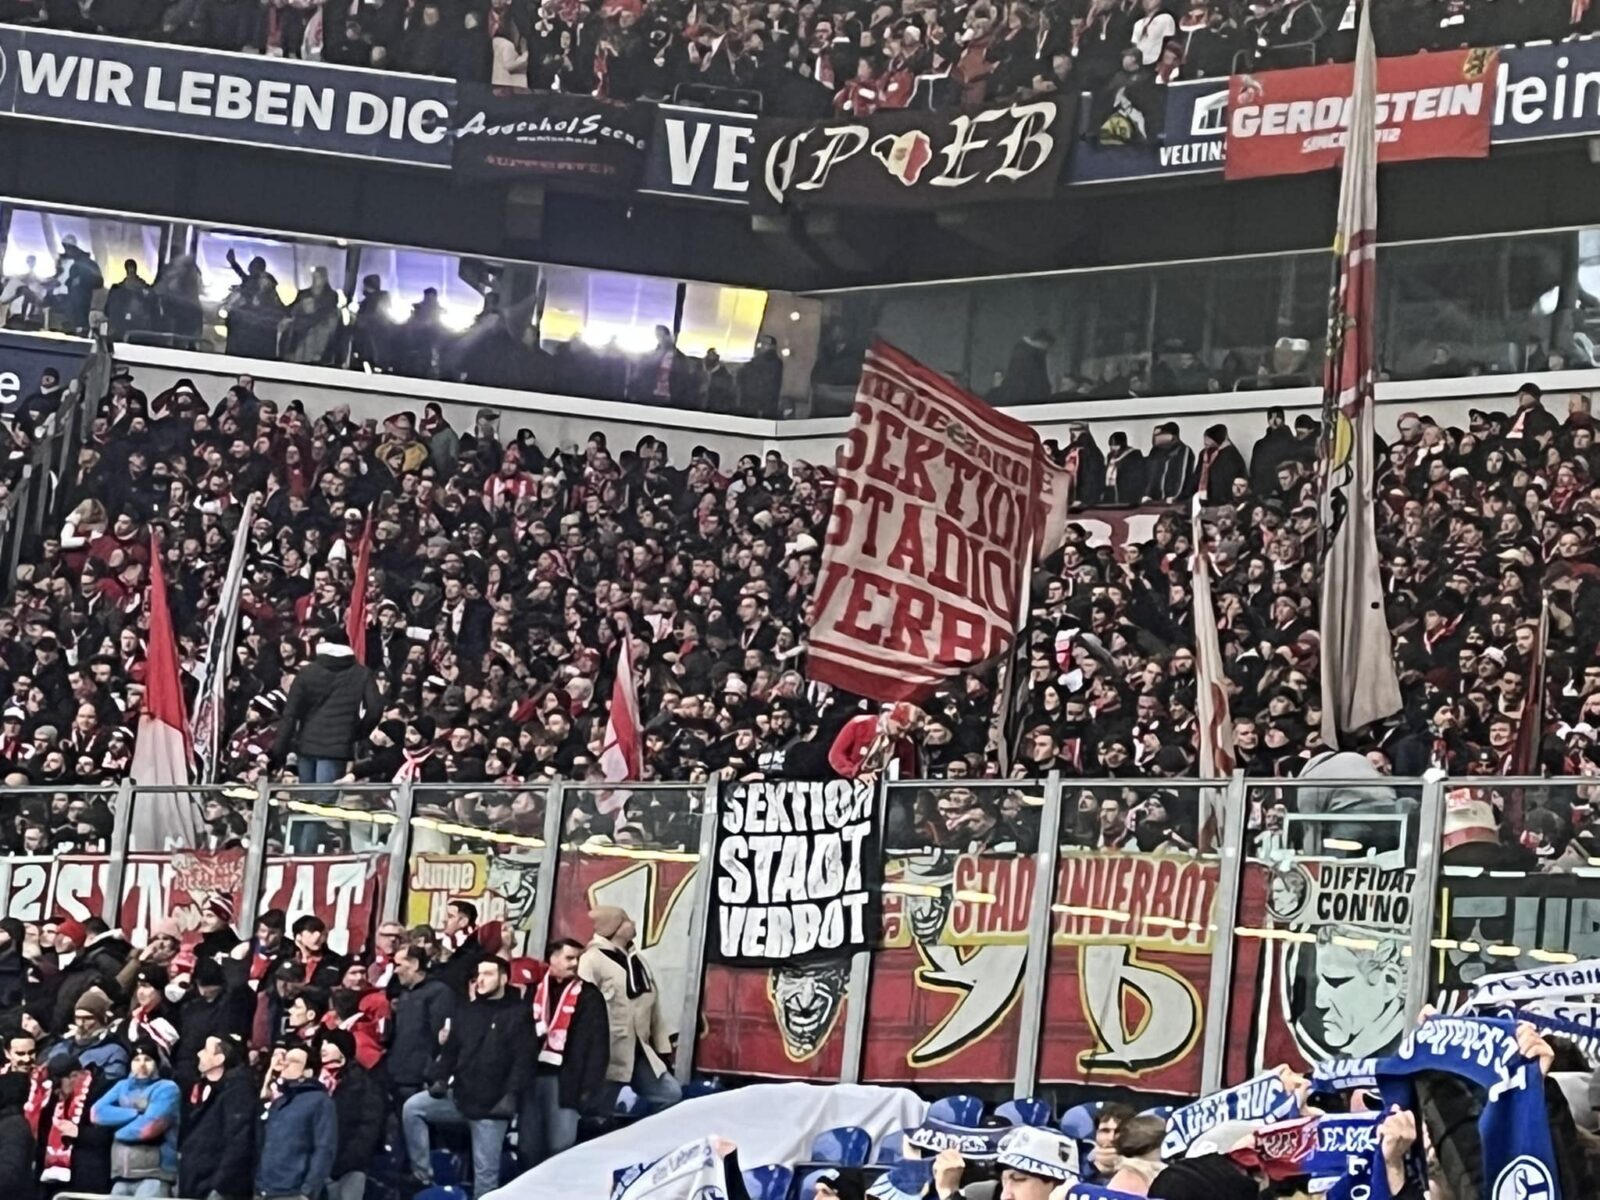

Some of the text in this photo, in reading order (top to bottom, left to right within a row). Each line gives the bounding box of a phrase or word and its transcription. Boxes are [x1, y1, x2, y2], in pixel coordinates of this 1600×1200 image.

[18, 50, 449, 145] WIR LEBEN DIC
[835, 402, 1030, 556] SEKTIO
[722, 779, 875, 834] SEKTION
[718, 820, 871, 904] STADT
[953, 857, 1221, 944] STADONVERBOT
[718, 892, 869, 958] VERBOT
